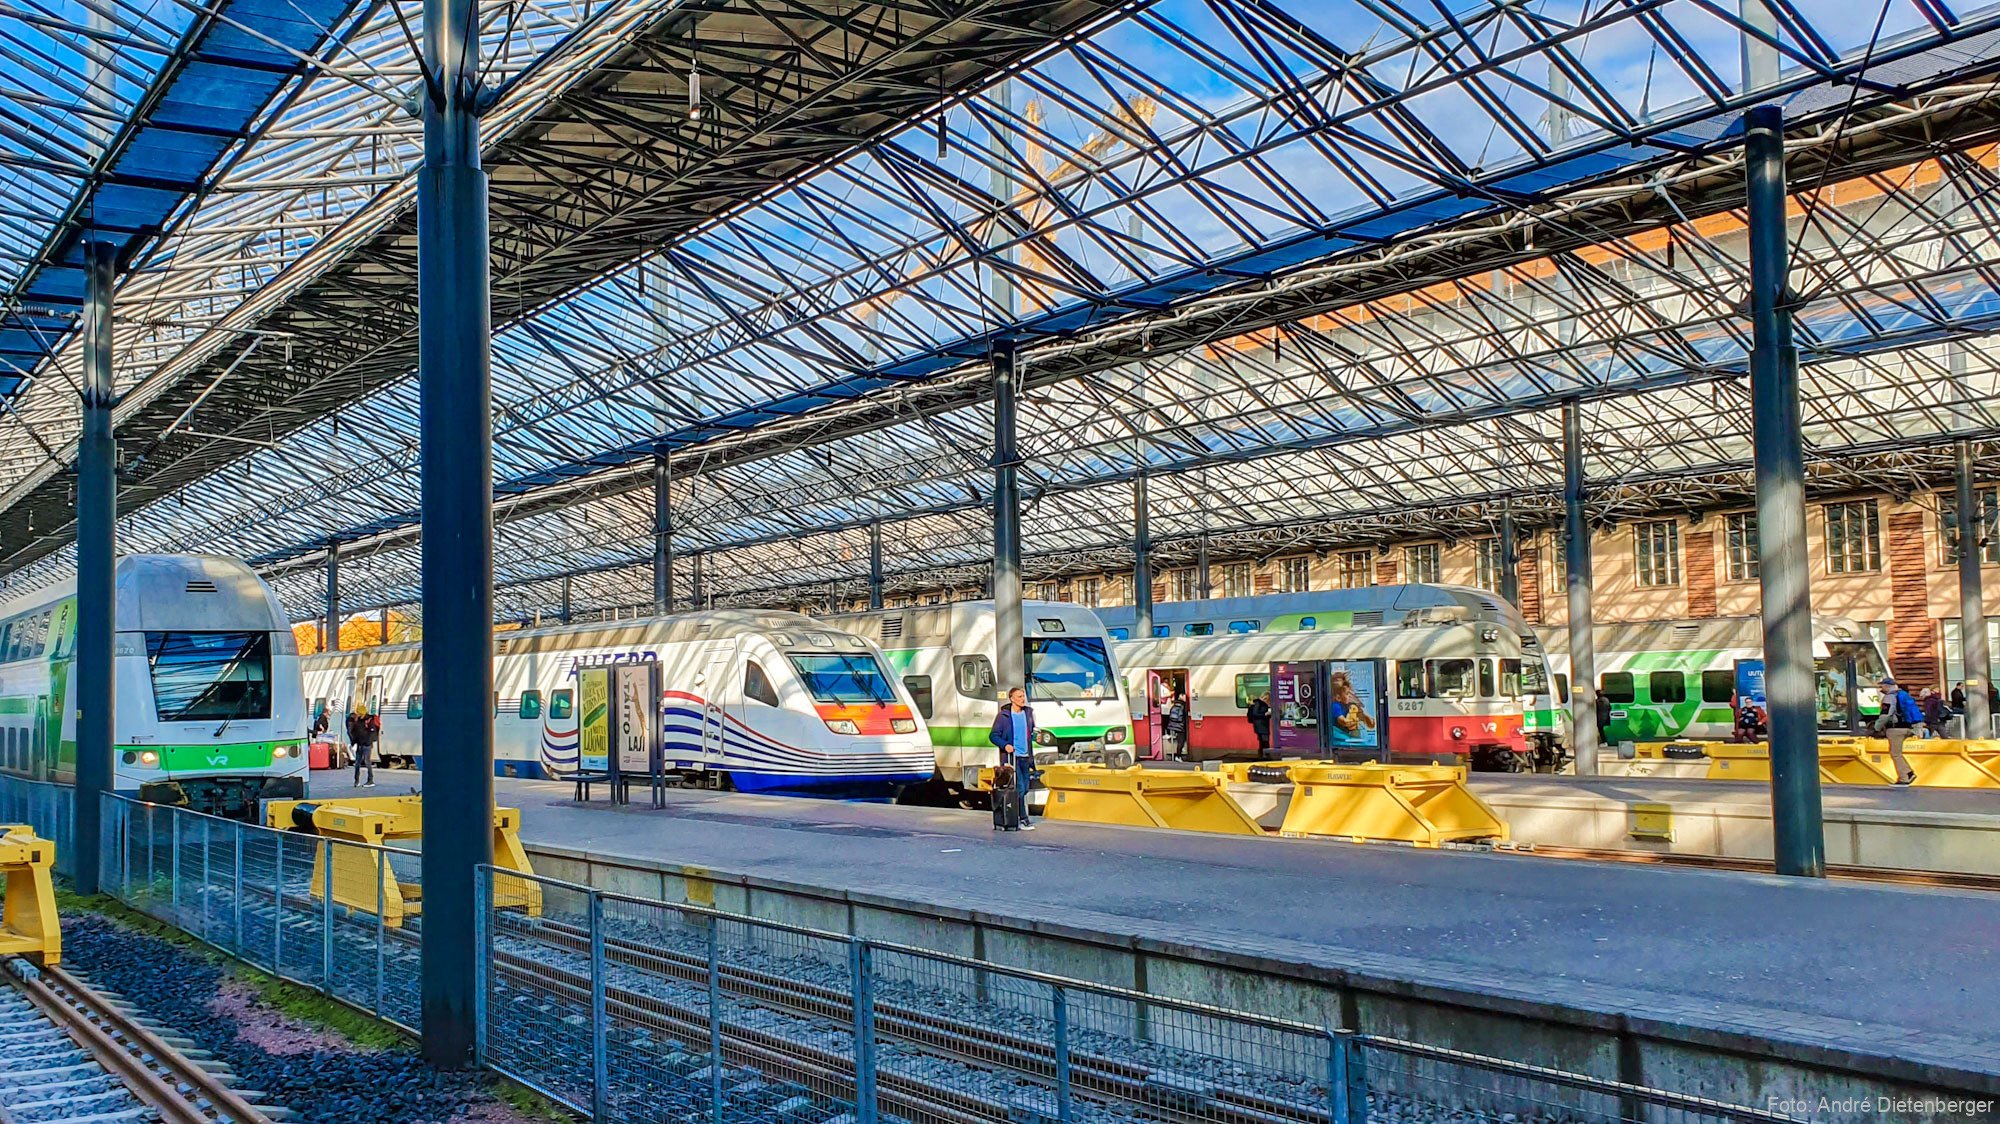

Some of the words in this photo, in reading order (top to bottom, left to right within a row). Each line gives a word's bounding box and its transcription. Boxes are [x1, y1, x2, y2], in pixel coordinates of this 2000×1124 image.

[1397, 701, 1424, 711] 6287
[1066, 708, 1086, 719] VR
[1481, 722, 1497, 733] VR
[206, 755, 228, 766] VR
